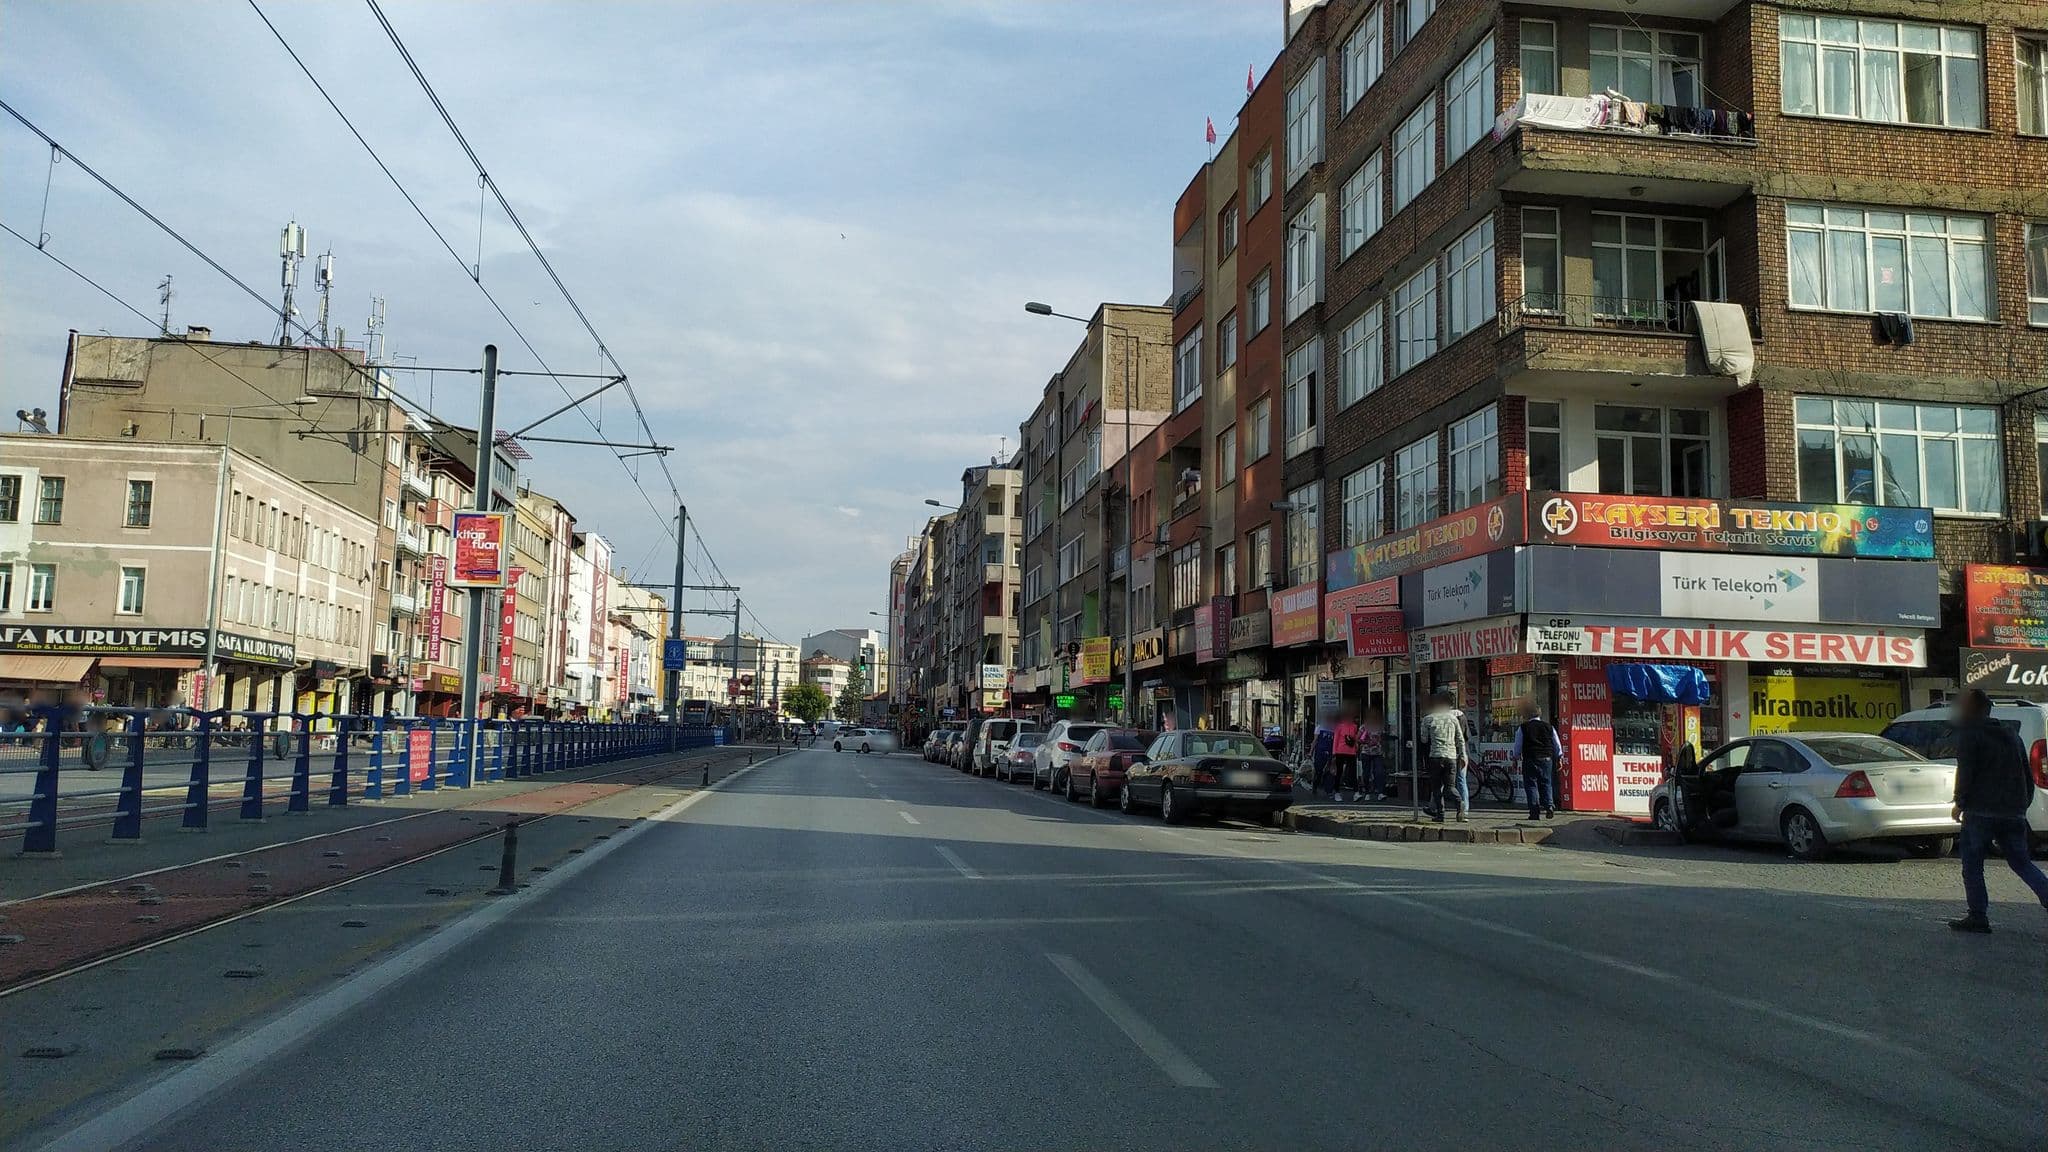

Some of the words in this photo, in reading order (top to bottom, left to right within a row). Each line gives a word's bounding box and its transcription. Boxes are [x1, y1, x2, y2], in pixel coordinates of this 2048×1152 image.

[1582, 502, 1720, 528] KAYSERİ
[1729, 508, 1840, 532] TEKNO
[456, 527, 486, 540] kitap
[1424, 516, 1477, 548] TEKNO
[1610, 527, 1697, 543] Bilgisayar
[1702, 530, 1761, 544] Teknik
[1766, 532, 1816, 546] Servis
[1901, 538, 1928, 547] SONY
[433, 571, 444, 612] HOTEL
[1427, 588, 1442, 602] Türk
[1443, 582, 1471, 598] Telekom
[1672, 576, 1706, 591] Türk
[1712, 577, 1777, 593] Telekom
[1550, 619, 1571, 628] CEP
[46, 629, 206, 649] KURUYEMİŞ
[430, 615, 440, 659] ÖZBEK
[501, 594, 513, 687] HOTEL
[1431, 626, 1471, 660] TEKNİK
[1475, 620, 1520, 656] SERVİS
[1539, 630, 1580, 640] TELEFONU
[1584, 624, 1749, 657] TEKNİK
[1765, 630, 1914, 664] SERVİS
[217, 634, 242, 652] SAFA
[243, 638, 294, 661] KURUYEMİŞ
[1536, 642, 1582, 652] TABLET
[1966, 667, 1988, 684] Gold
[1989, 653, 2012, 673] Chef
[1573, 683, 1606, 700] TELEFON
[1753, 691, 1897, 719] liramatik.org
[1572, 713, 1612, 731] AKSESUAR
[1579, 740, 1608, 762] TEKNİK
[1582, 770, 1609, 792] SERVİS
[1617, 776, 1655, 785] TELEFON
